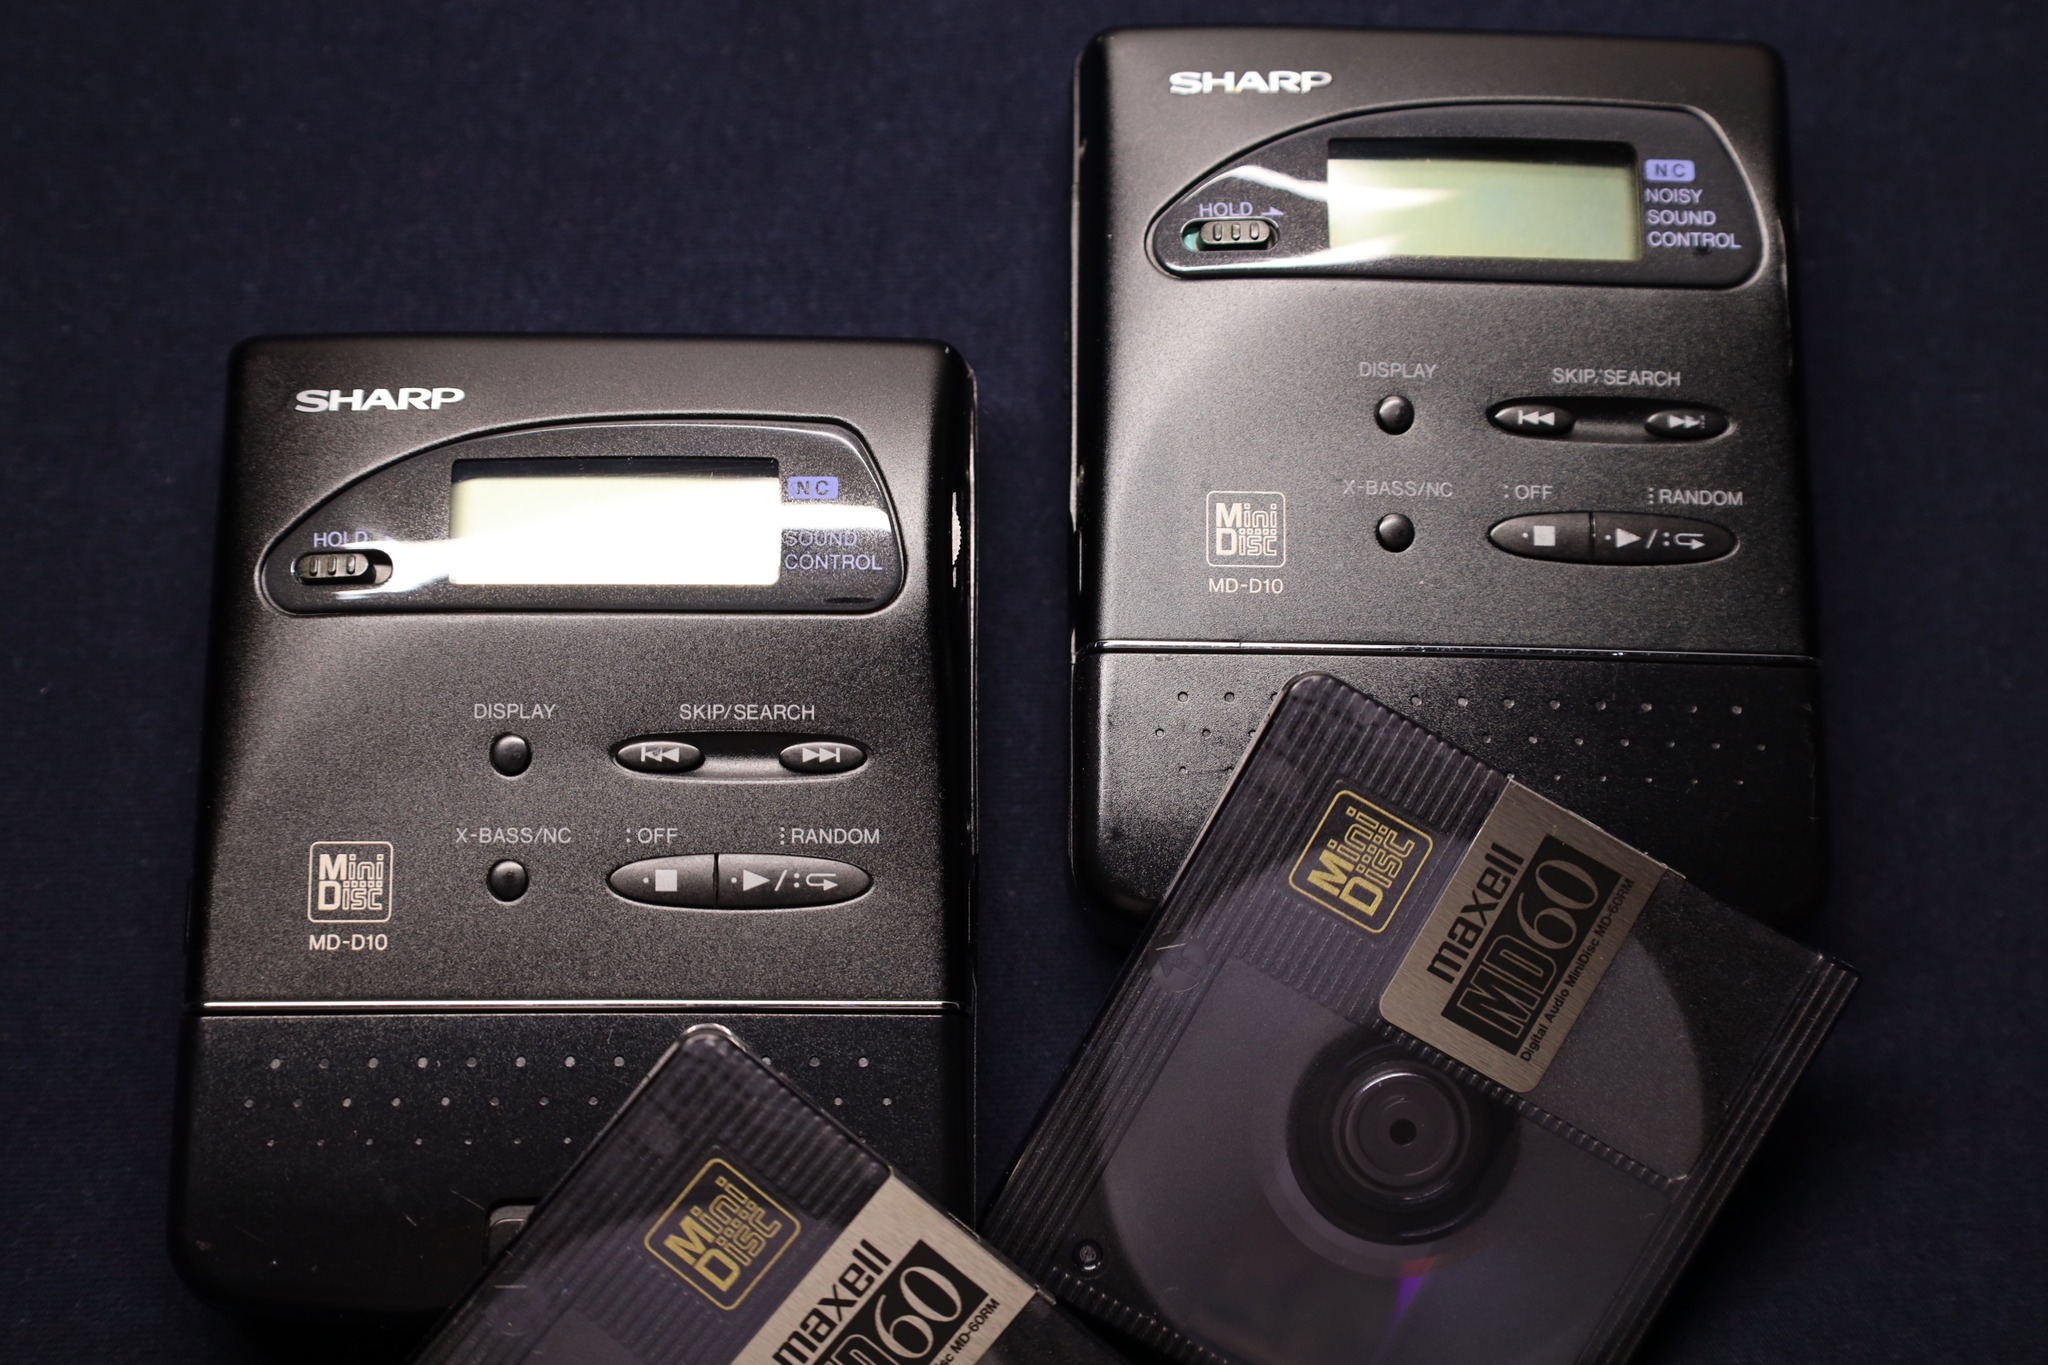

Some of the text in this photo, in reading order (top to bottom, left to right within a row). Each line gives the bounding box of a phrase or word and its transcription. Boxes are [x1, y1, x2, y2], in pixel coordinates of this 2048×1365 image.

[1169, 70, 1333, 95] SHARP
[1655, 163, 1687, 178] NC
[1645, 187, 1703, 204] NOISY
[1199, 202, 1254, 217] HOLD
[1647, 208, 1717, 226] SOUND
[1647, 230, 1742, 249] CONTROL
[1359, 362, 1438, 379] DISPLAY
[1552, 367, 1681, 387] SKIP/SEARCH
[294, 387, 466, 413] SHARP
[796, 480, 829, 496] NC
[1343, 480, 1453, 497] X-BASS/NC
[1659, 488, 1743, 506] RANDOM
[1215, 502, 1278, 528] Mini
[785, 531, 858, 547] SOUND
[784, 553, 884, 570] CONTROL
[1209, 578, 1284, 595] MD-D10
[473, 703, 556, 719] DISPLAY
[679, 703, 815, 721] SKIP/SEARCH
[456, 828, 571, 844] X-BASS/NC
[791, 828, 880, 845] RANDOM
[1307, 805, 1379, 897] Mini
[319, 853, 385, 880] Mini
[1426, 842, 1525, 984] maxell
[309, 934, 388, 951] MD-D10
[1456, 859, 1599, 1039] MD60
[1519, 878, 1636, 1062] Digital Audio MiniDisc MD-60RM
[663, 1175, 750, 1266] Mini
[772, 1239, 892, 1365] maxell
[949, 1298, 1000, 1354] MD-60RM
